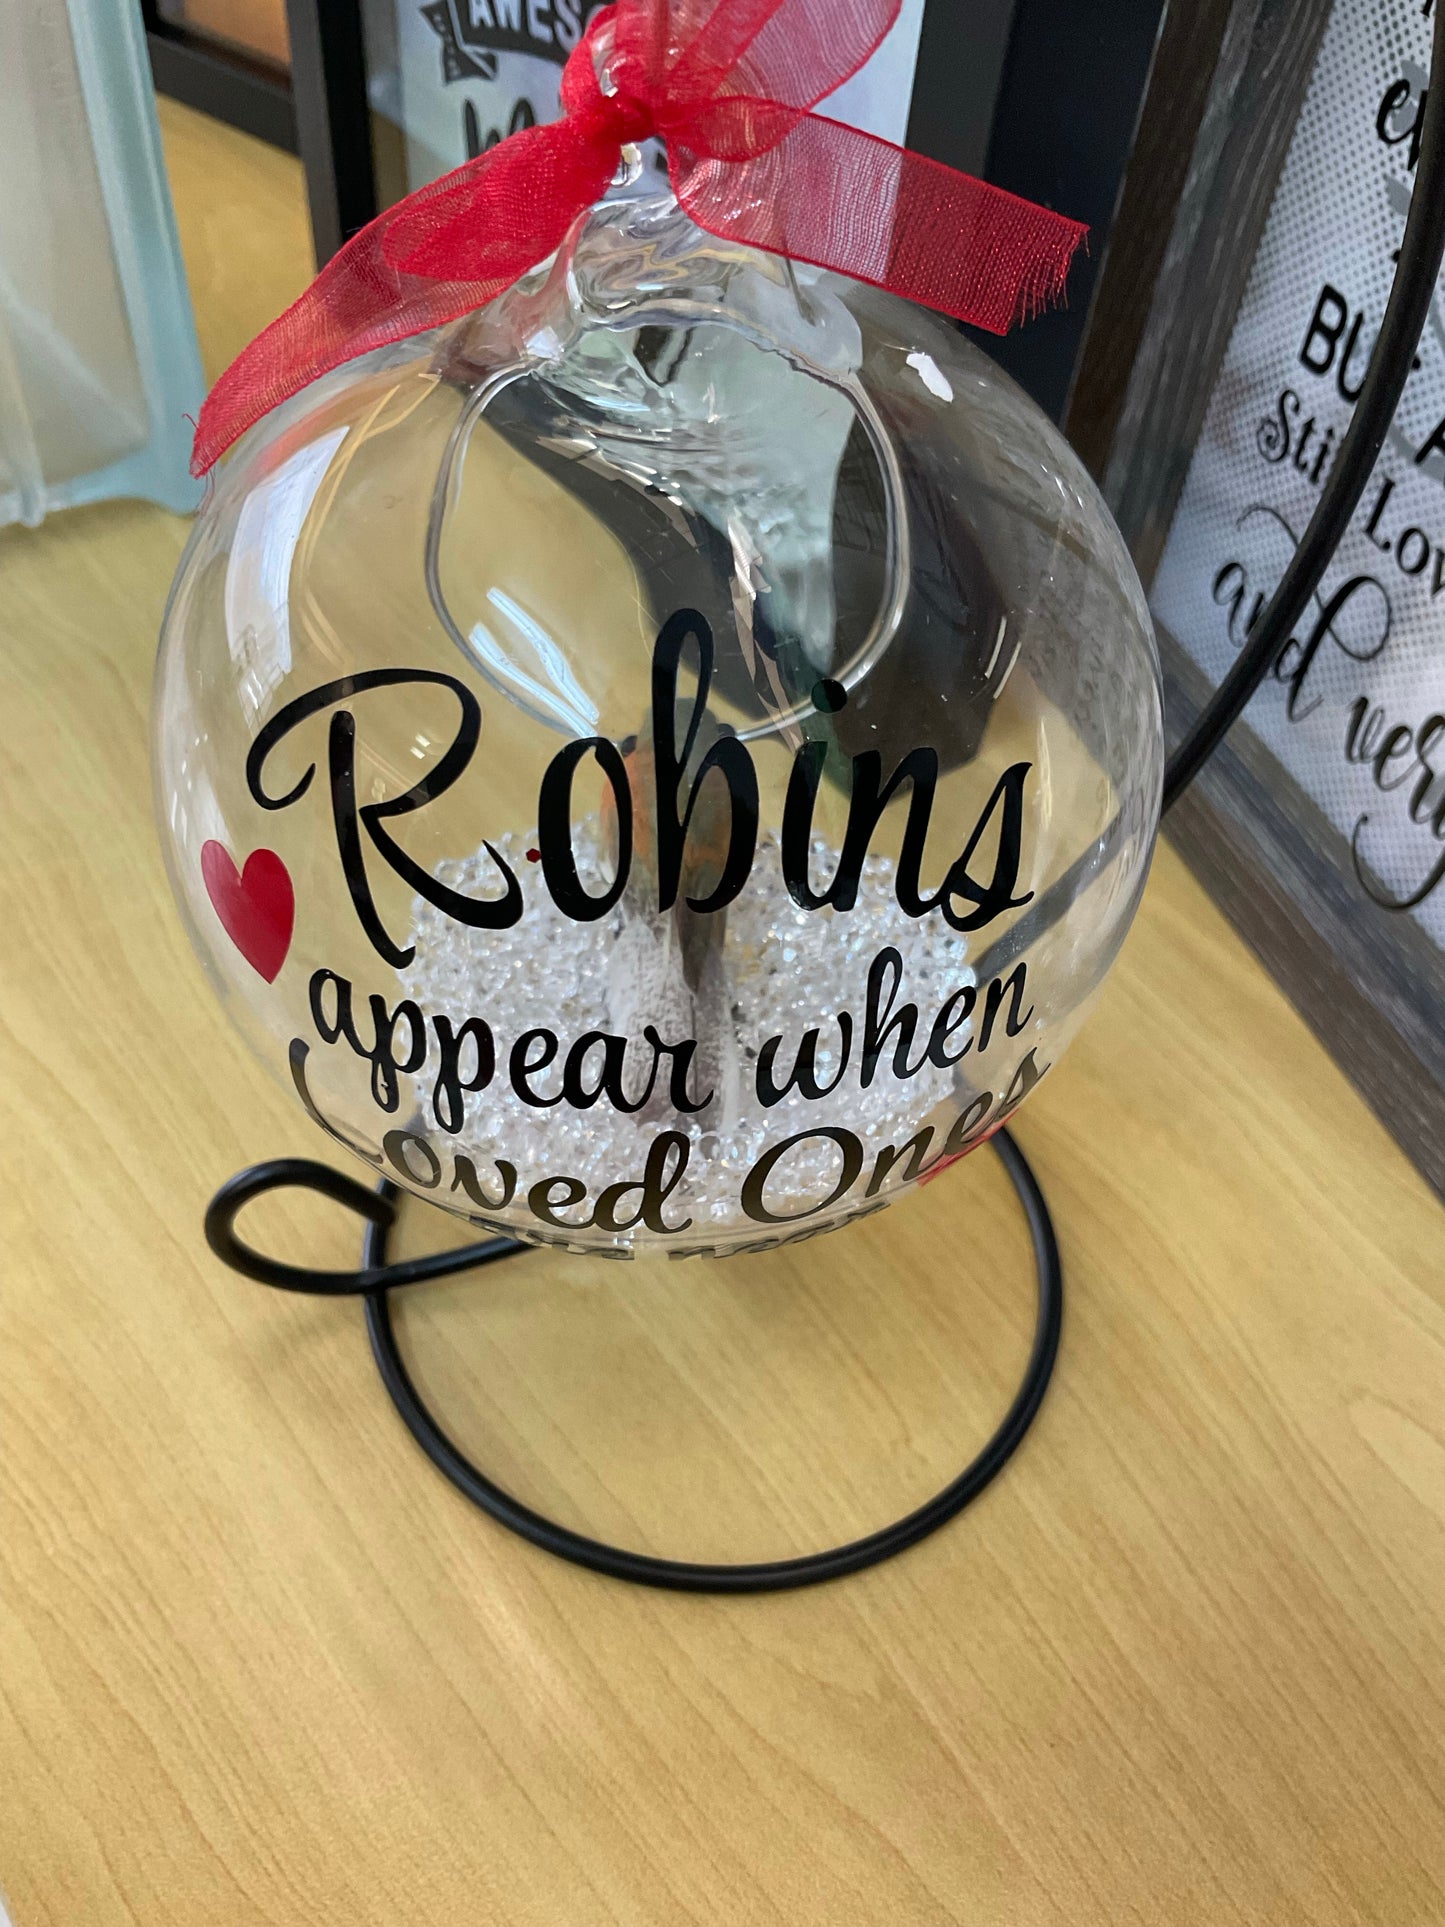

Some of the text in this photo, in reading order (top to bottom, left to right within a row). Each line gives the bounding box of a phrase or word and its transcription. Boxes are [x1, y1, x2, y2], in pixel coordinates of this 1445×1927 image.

[468, 0, 598, 51] AWES
[1301, 284, 1367, 404] BU
[1257, 389, 1334, 484] Sti
[246, 608, 1035, 969] Robins
[308, 945, 1035, 1134] appear when
[740, 1046, 1052, 1225] Ones
